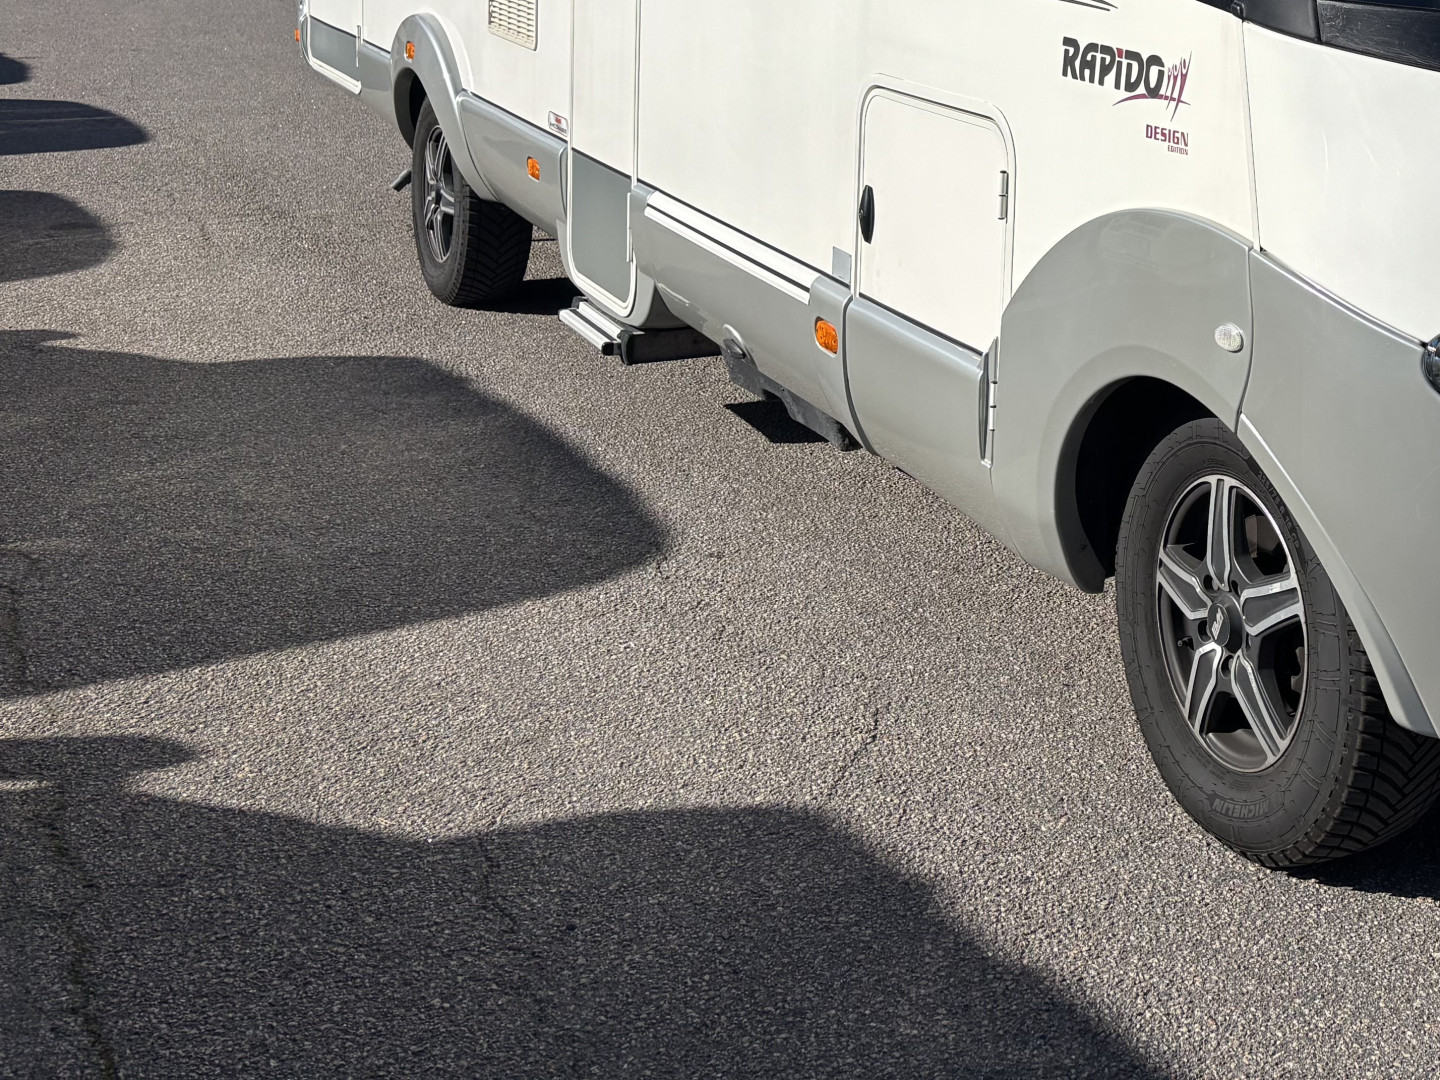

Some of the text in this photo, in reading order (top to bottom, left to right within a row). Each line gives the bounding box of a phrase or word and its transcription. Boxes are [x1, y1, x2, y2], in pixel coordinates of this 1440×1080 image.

[1145, 123, 1189, 148] DESIGN
[1167, 144, 1189, 156] EDITION
[1211, 798, 1270, 819] MICHELIN
